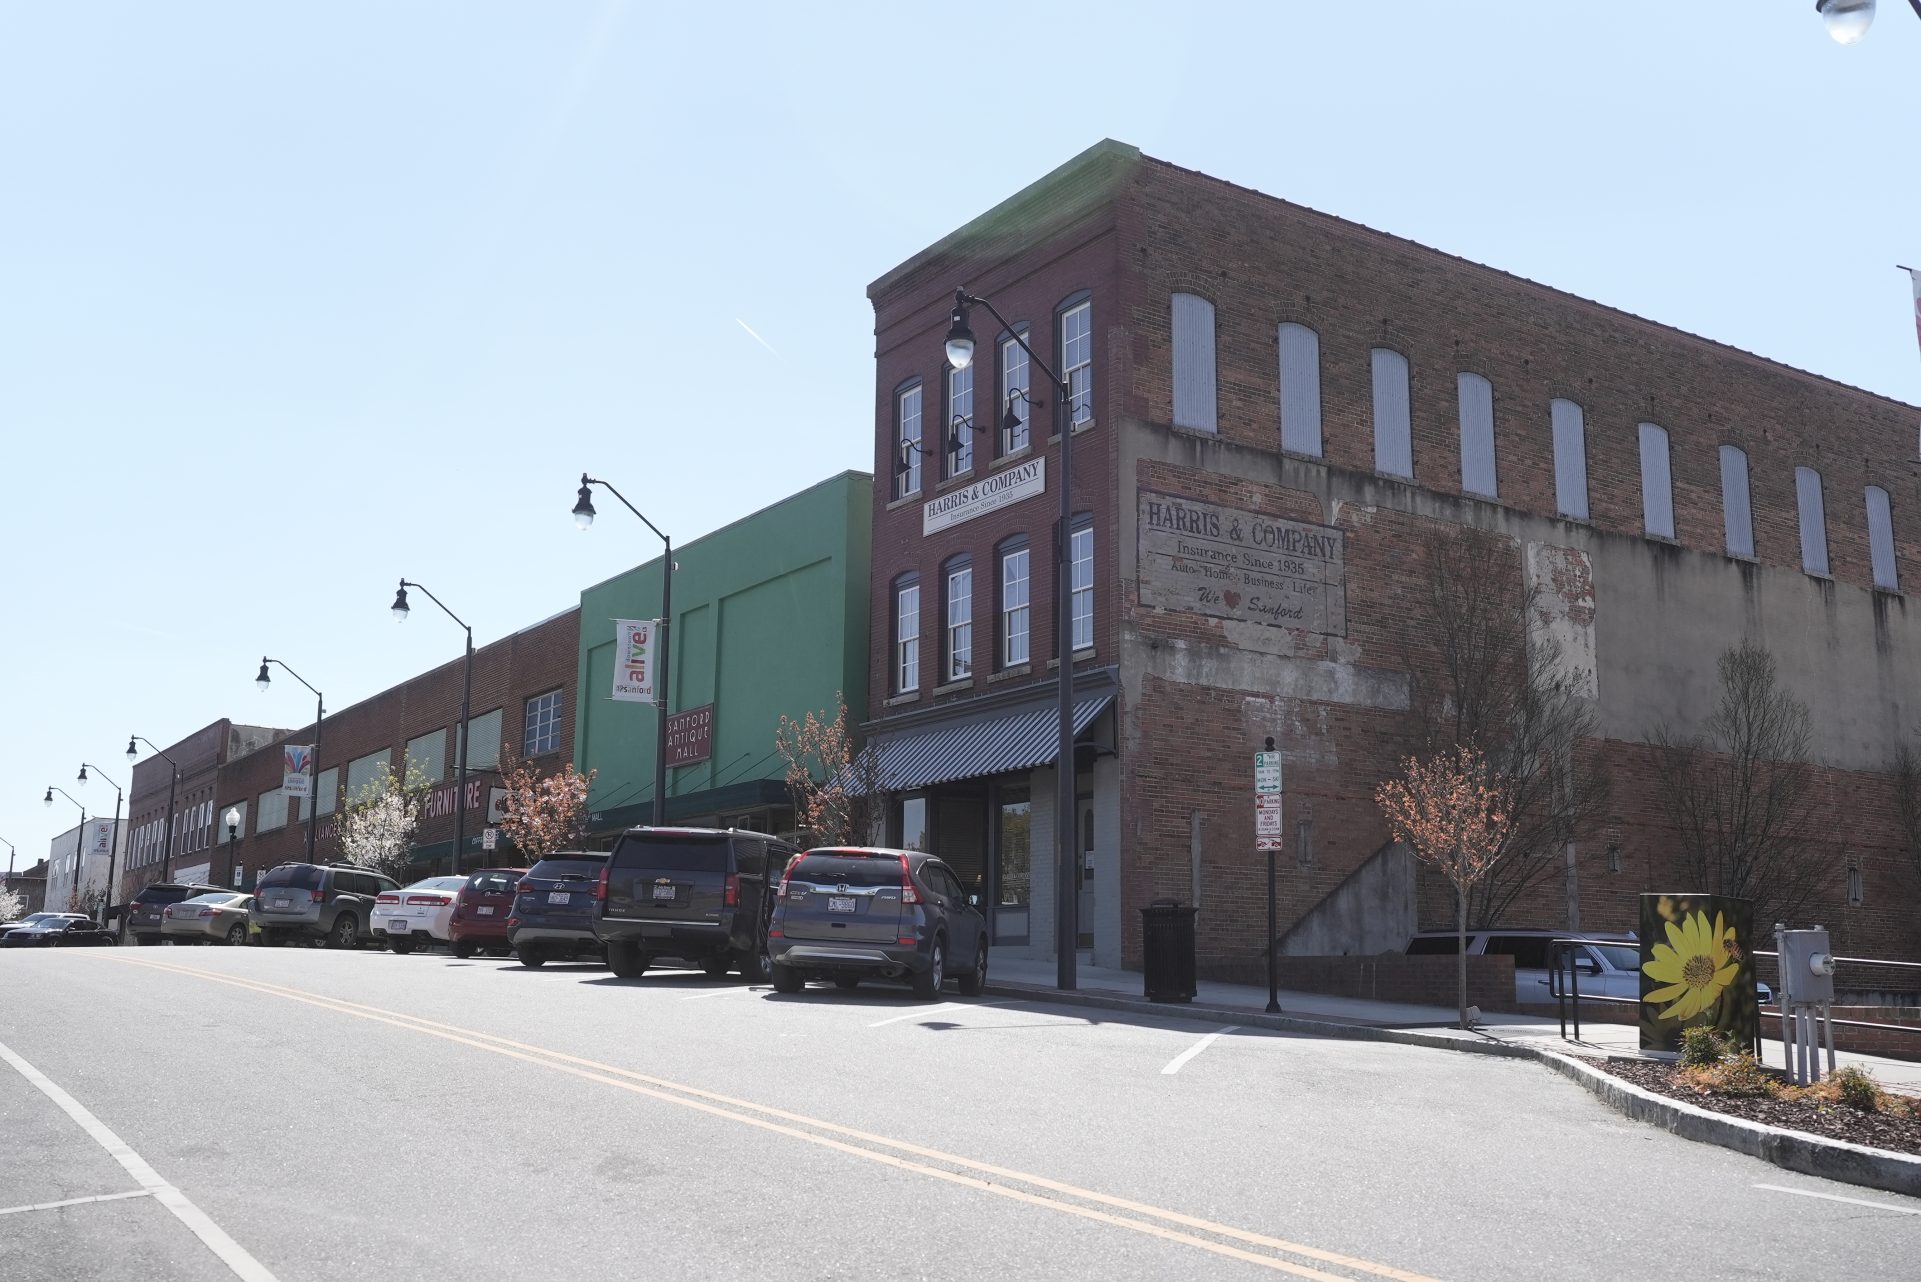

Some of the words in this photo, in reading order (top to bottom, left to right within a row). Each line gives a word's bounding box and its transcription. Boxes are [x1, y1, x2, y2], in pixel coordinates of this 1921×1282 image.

[928, 490, 969, 517] HARRIS
[971, 486, 980, 501] &
[982, 461, 1039, 496] COMPANY
[950, 505, 980, 521] Insurance
[981, 500, 996, 511] Since
[999, 491, 1014, 503] 1935
[1148, 502, 1219, 537] HARRIS
[1229, 518, 1244, 542] &
[1252, 522, 1337, 559] COMPANY
[1177, 540, 1238, 563] Insurance
[1243, 553, 1274, 570] Since
[1278, 560, 1304, 575] 1935
[1244, 573, 1284, 591] Business
[1293, 582, 1313, 595] Life
[1197, 587, 1221, 604] We
[1248, 596, 1304, 620] Sanford
[625, 631, 647, 683] alive
[667, 726, 708, 747] ANTIQUE
[668, 711, 710, 733] SANFORD
[676, 746, 699, 759] MALL
[1256, 754, 1263, 766] 2
